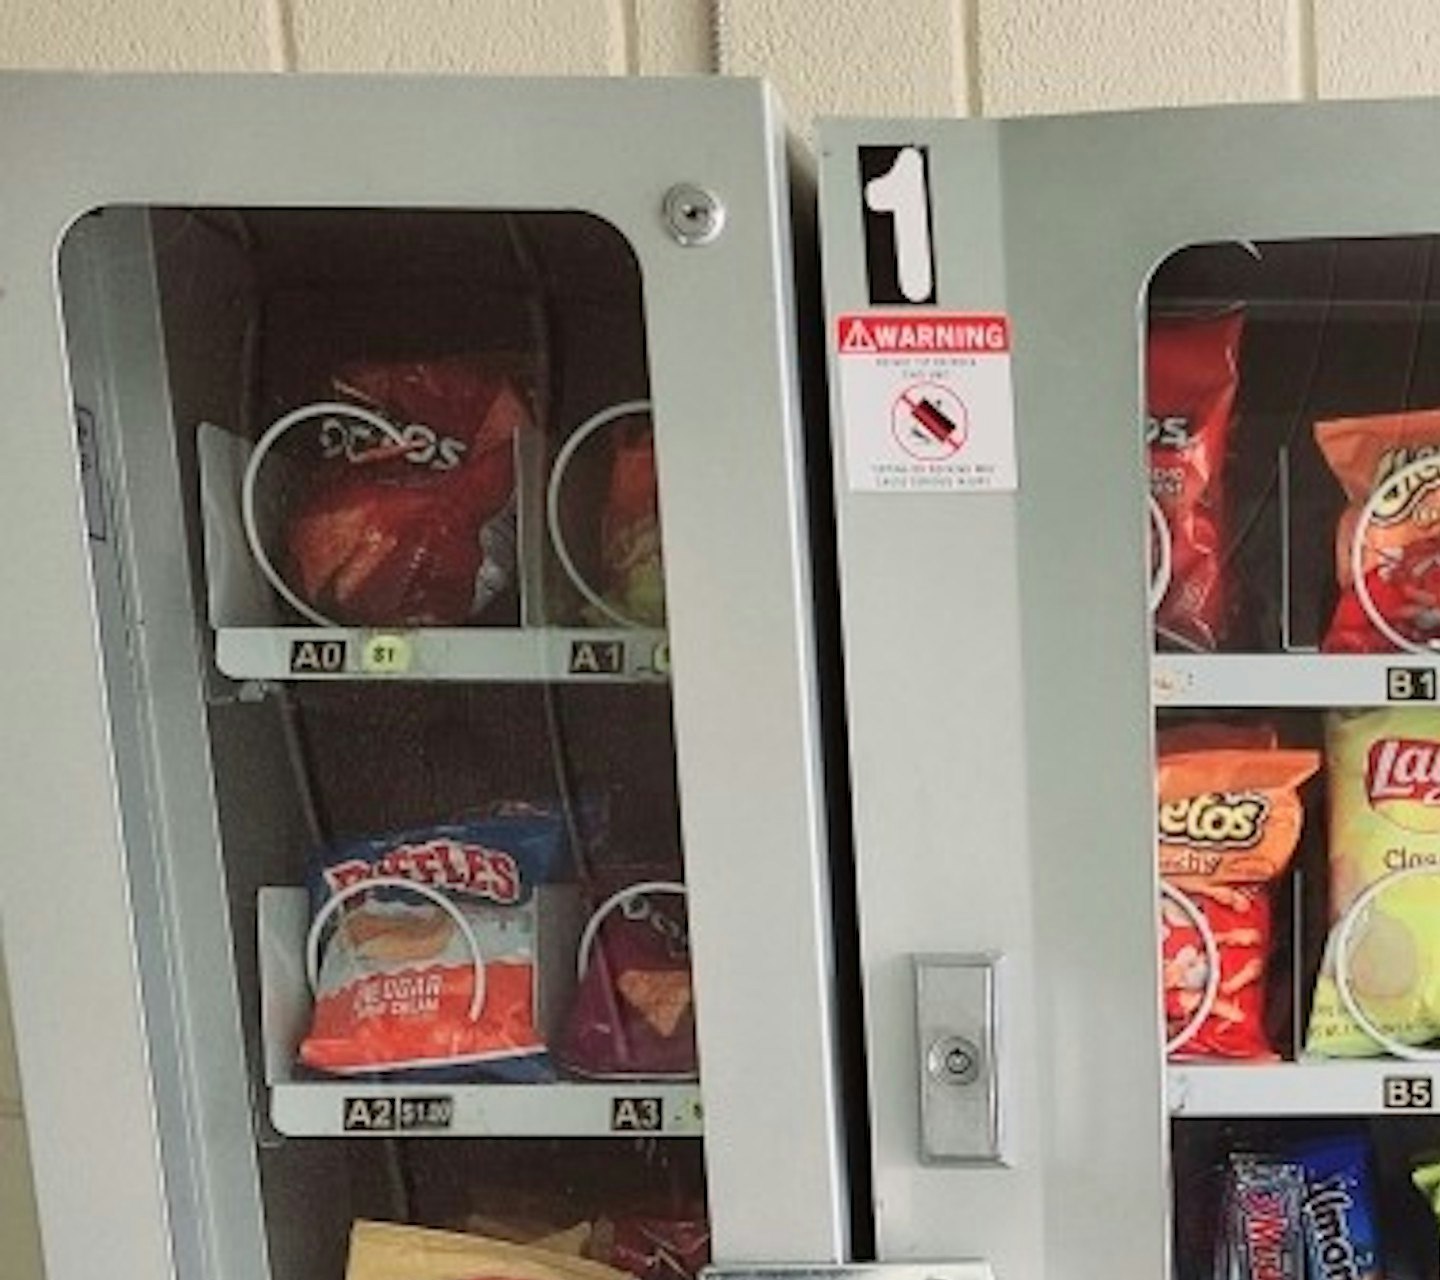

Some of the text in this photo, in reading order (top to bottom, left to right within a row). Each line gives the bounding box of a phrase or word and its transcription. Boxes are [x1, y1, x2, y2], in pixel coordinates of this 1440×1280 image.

[865, 147, 934, 302] 1
[874, 323, 1004, 349] WARNING
[294, 642, 343, 669] A0
[573, 642, 622, 670] A1
[1389, 670, 1435, 699] B1
[1389, 1080, 1431, 1108] B5
[346, 1099, 393, 1128] A2
[615, 1099, 661, 1129] A3
